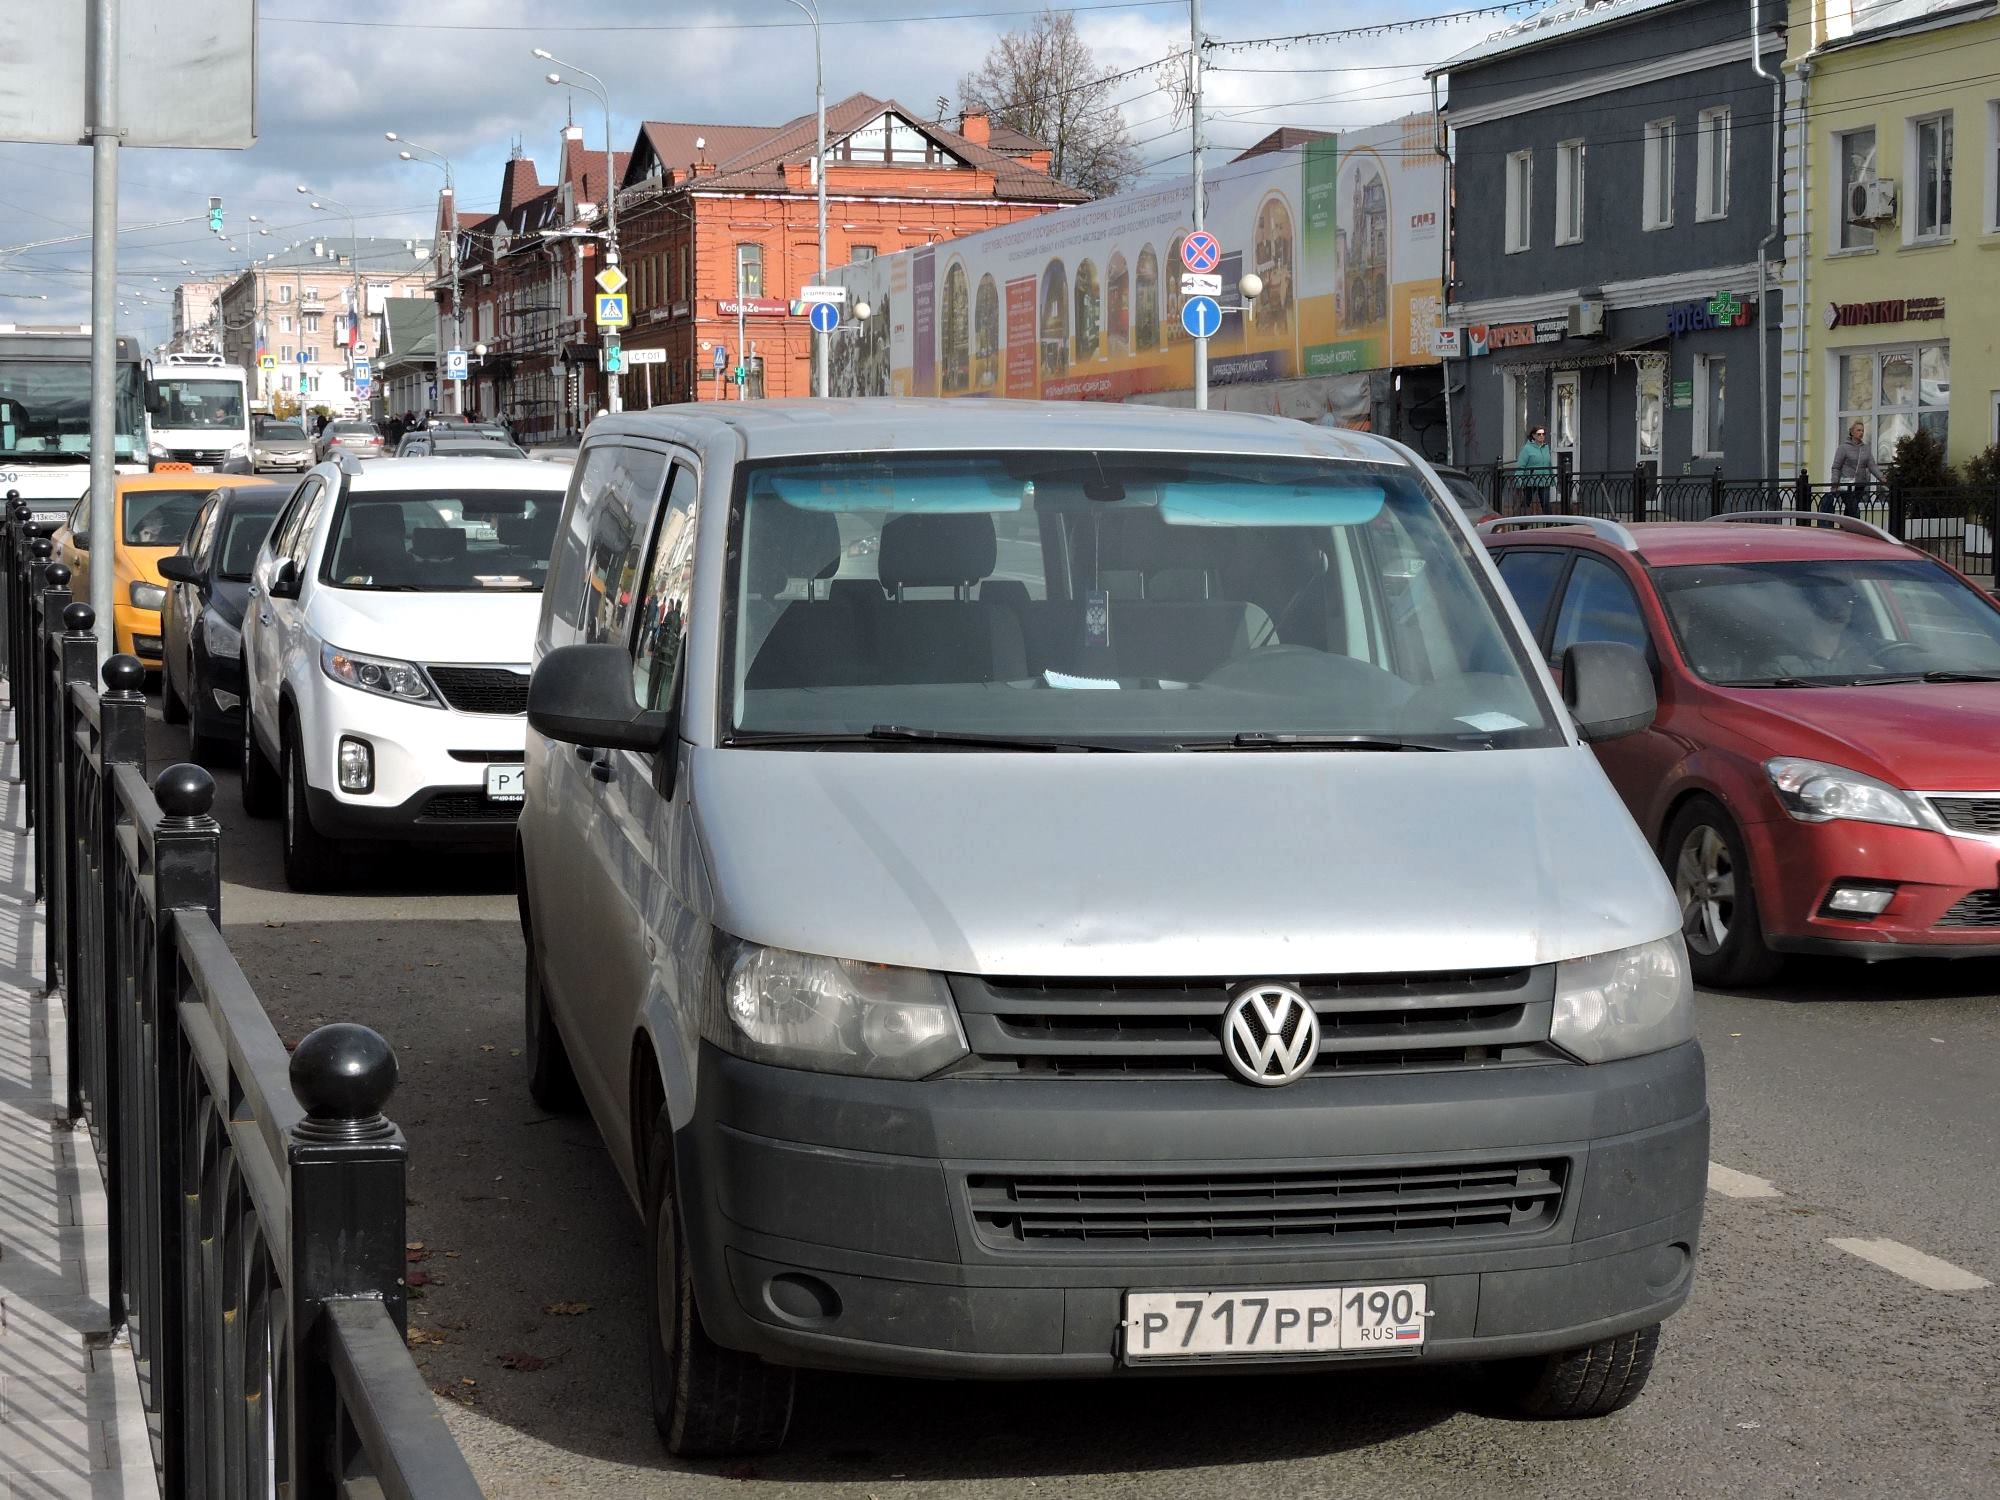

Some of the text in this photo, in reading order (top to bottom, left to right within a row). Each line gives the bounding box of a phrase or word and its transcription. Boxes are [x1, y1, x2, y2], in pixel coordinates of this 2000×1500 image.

[1840, 299, 1904, 326] ПЛАТКИ
[1143, 1289, 1414, 1349] Р717РР 190
[1360, 1328, 1394, 1341] RUS
